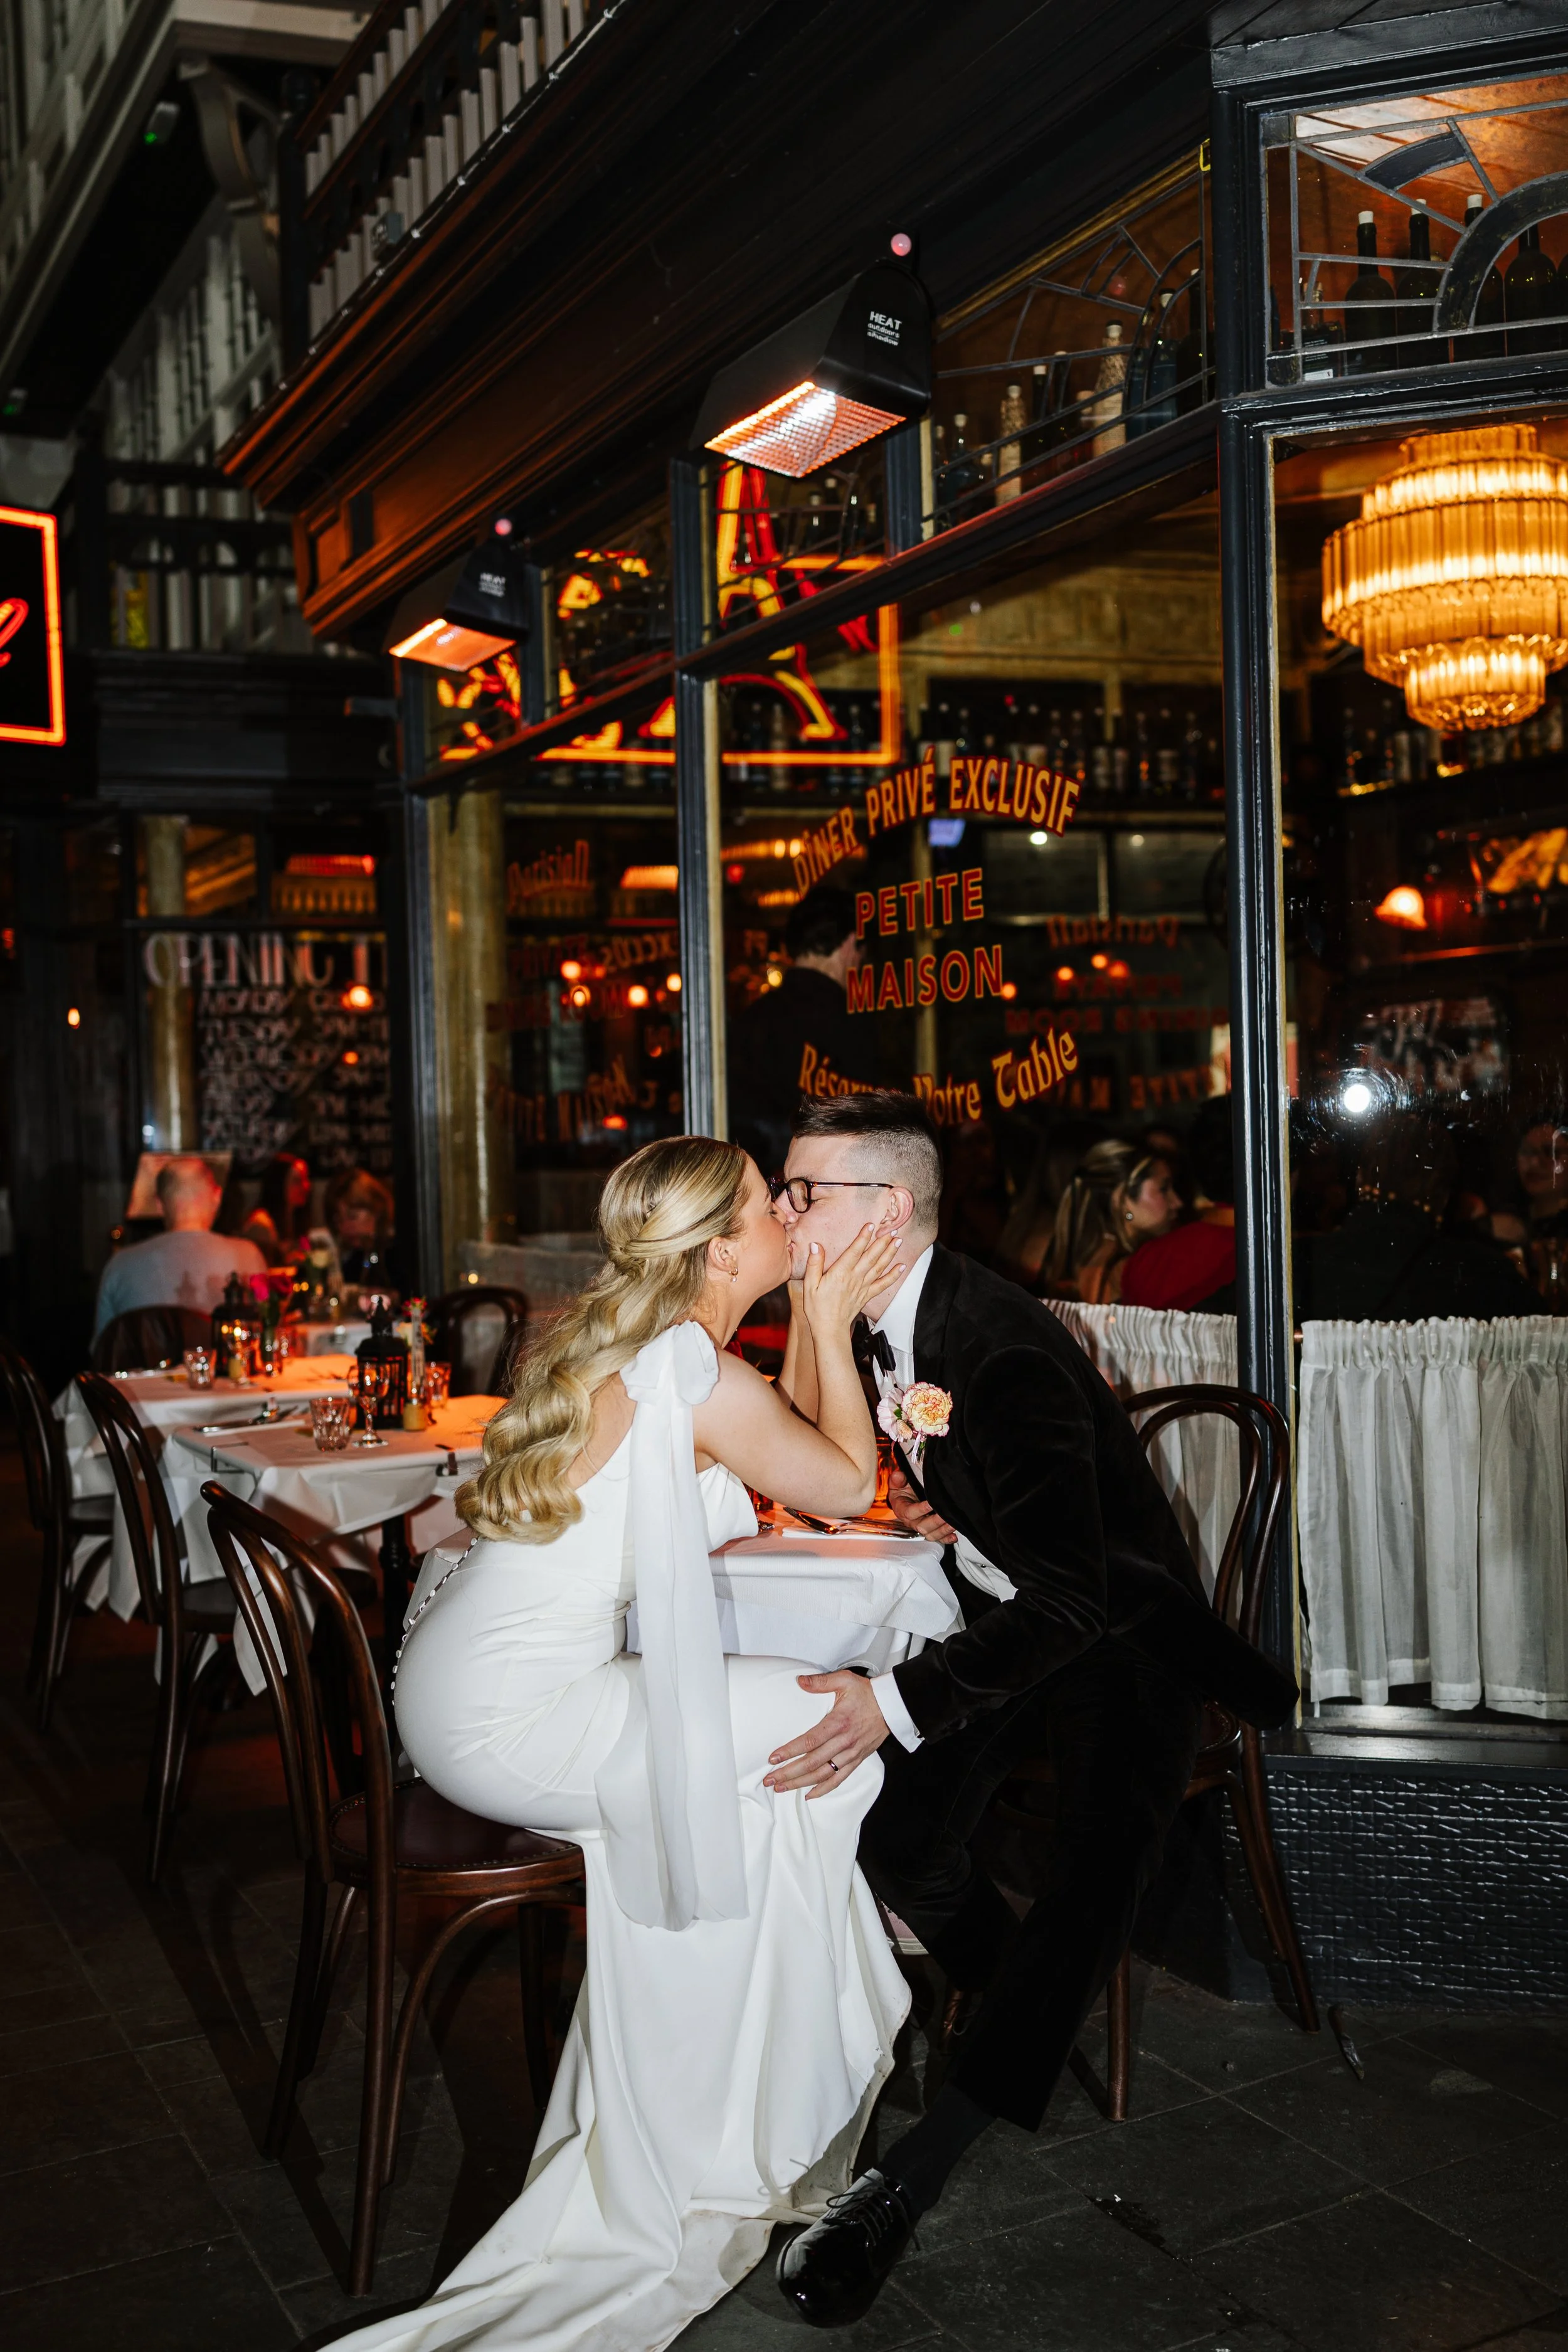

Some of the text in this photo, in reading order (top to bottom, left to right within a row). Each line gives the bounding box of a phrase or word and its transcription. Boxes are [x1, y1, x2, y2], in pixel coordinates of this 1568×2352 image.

[870, 311, 902, 330] HEAT
[864, 745, 936, 838] PRIVÉ
[949, 755, 1081, 838] EXCLUSIF
[856, 867, 984, 940] PETITE
[847, 944, 1002, 1015] MAISON
[990, 1026, 1079, 1111] Table
